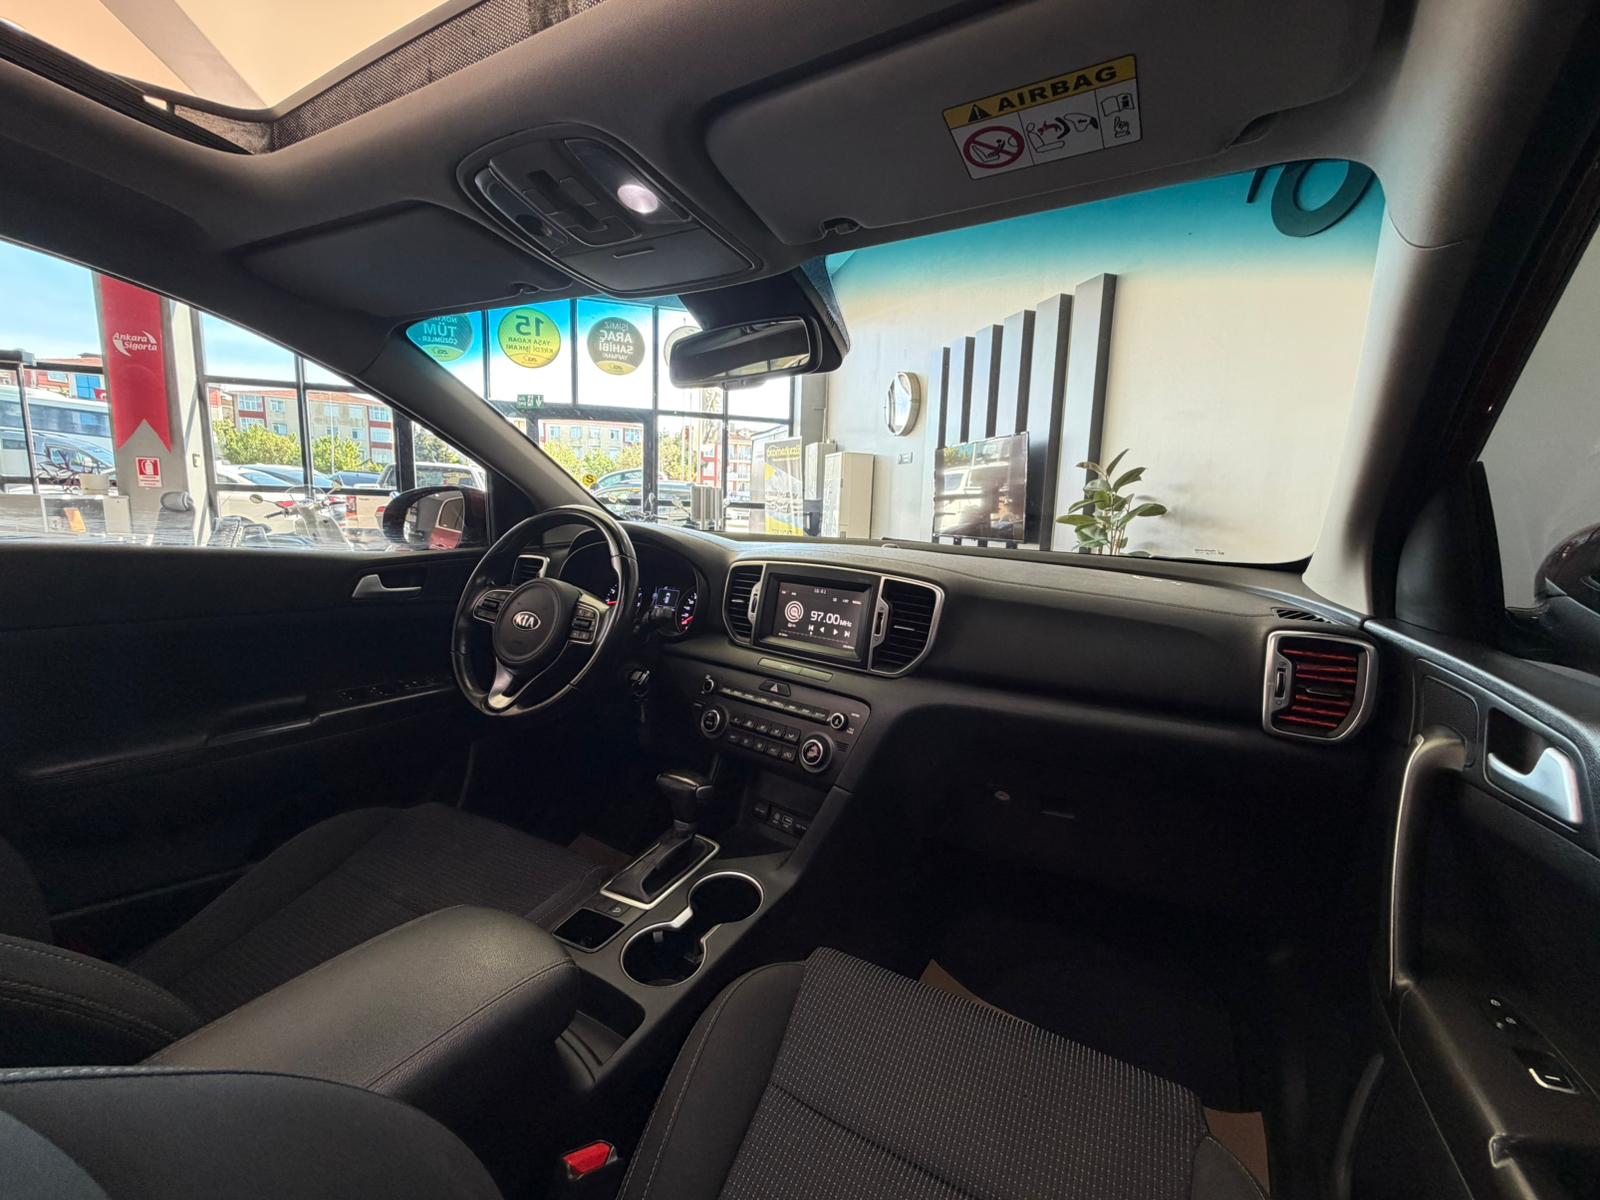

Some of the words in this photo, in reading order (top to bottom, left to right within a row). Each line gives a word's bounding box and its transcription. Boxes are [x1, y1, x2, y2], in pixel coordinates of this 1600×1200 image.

[997, 66, 1117, 113] AIRBAG
[112, 332, 148, 343] Ankara
[123, 341, 158, 351] Sigorta
[514, 613, 535, 629] KIA
[810, 610, 840, 625] 97.00
